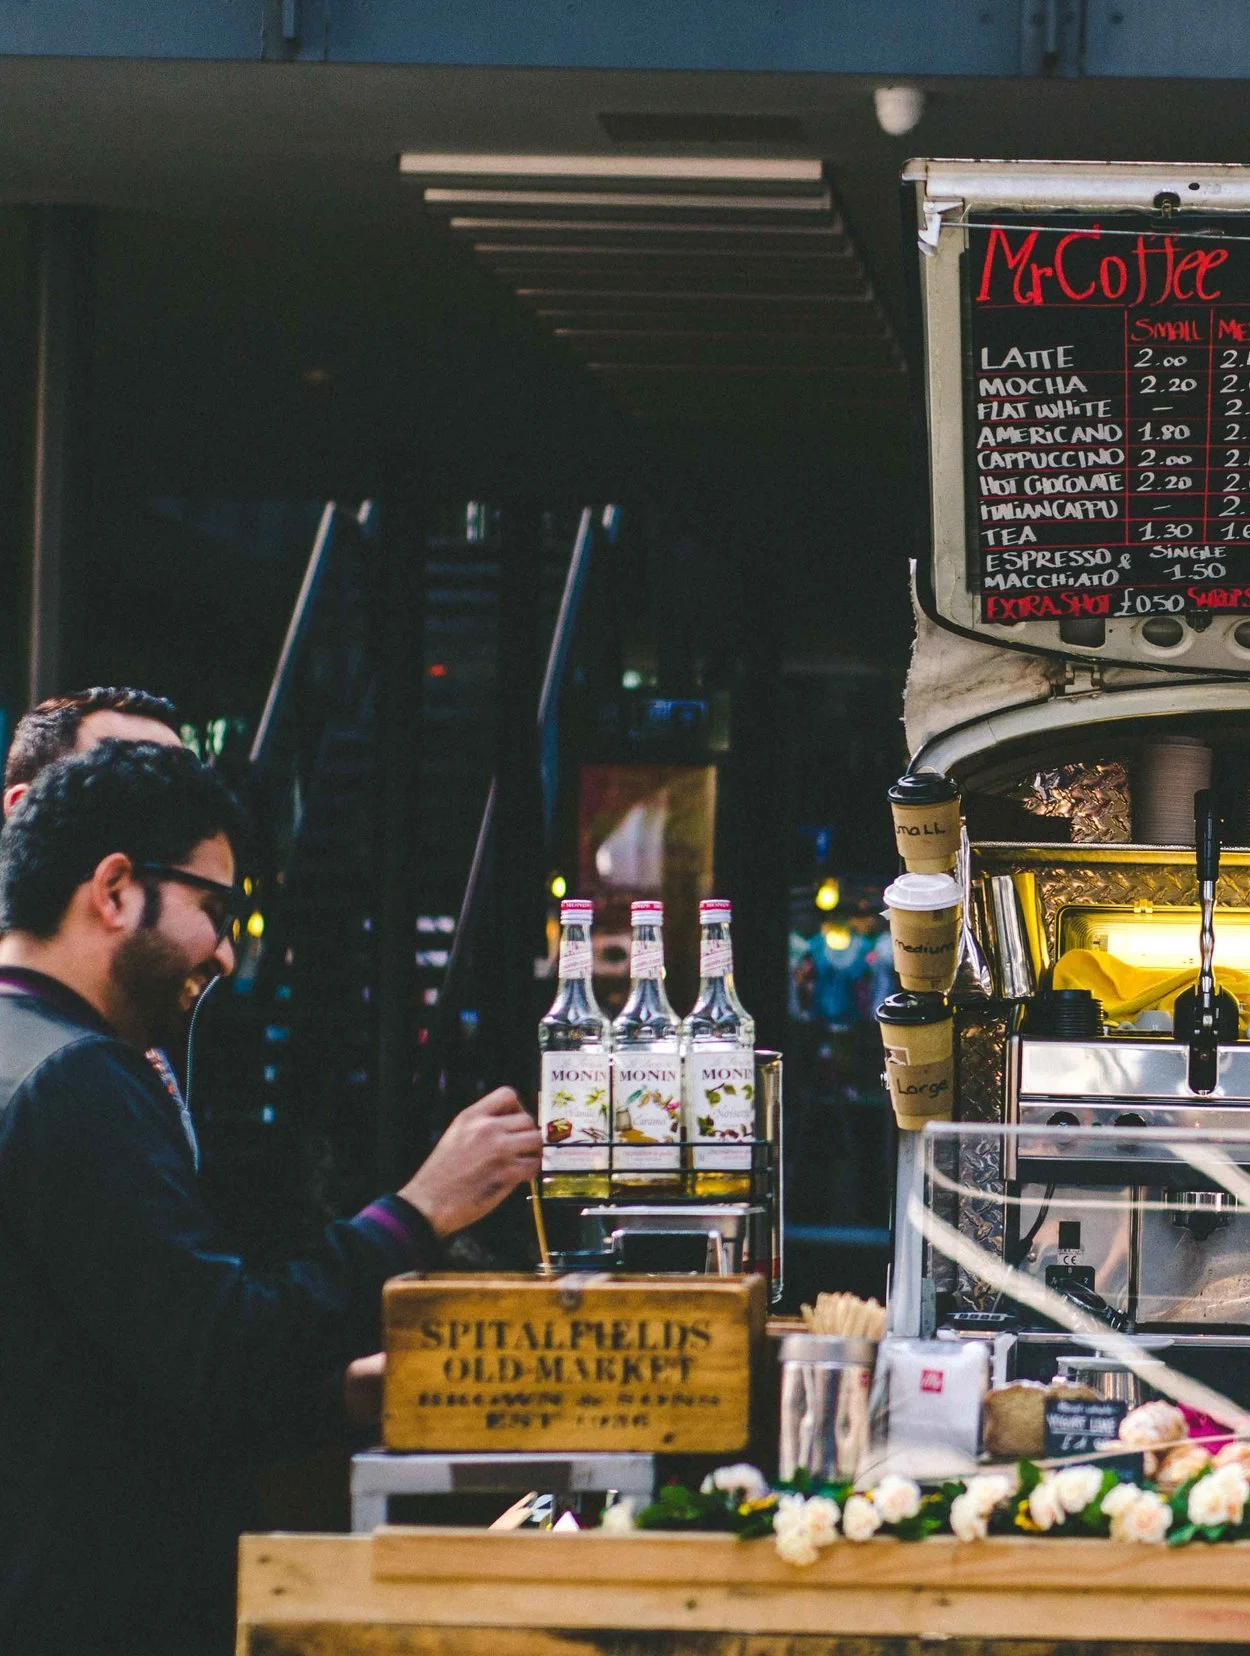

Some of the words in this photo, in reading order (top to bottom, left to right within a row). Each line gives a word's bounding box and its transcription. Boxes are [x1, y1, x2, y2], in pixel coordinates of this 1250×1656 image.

[1131, 317, 1202, 341] SMALL
[981, 345, 1075, 372] LATTE
[1134, 348, 1188, 368] 2.00
[978, 375, 1088, 398] MOCHA
[1139, 376, 1198, 395] 2.20
[976, 400, 1030, 421] FLAT
[1137, 422, 1191, 441] 1.80
[976, 448, 1125, 471] CAPPUCCINO
[1136, 449, 1193, 467] 2.00
[979, 475, 1020, 496] HOT
[1023, 472, 1125, 494] CHOCOLATE
[1136, 473, 1193, 491] 2.20
[981, 525, 1037, 547] TEA
[1138, 522, 1194, 541] 1.30
[985, 548, 1113, 573] ESPRESSO
[1162, 562, 1227, 581] 1.50
[986, 594, 1062, 621] EXTRA
[1060, 591, 1114, 617] SHOT
[1113, 586, 1185, 617] £0.50
[551, 1069, 607, 1081] MONIN
[619, 1069, 677, 1081] MONIN
[896, 1078, 949, 1099] Large
[420, 1318, 713, 1352] SPITALFIELDS
[442, 1355, 524, 1385] OLD
[534, 1355, 697, 1386] MARKET
